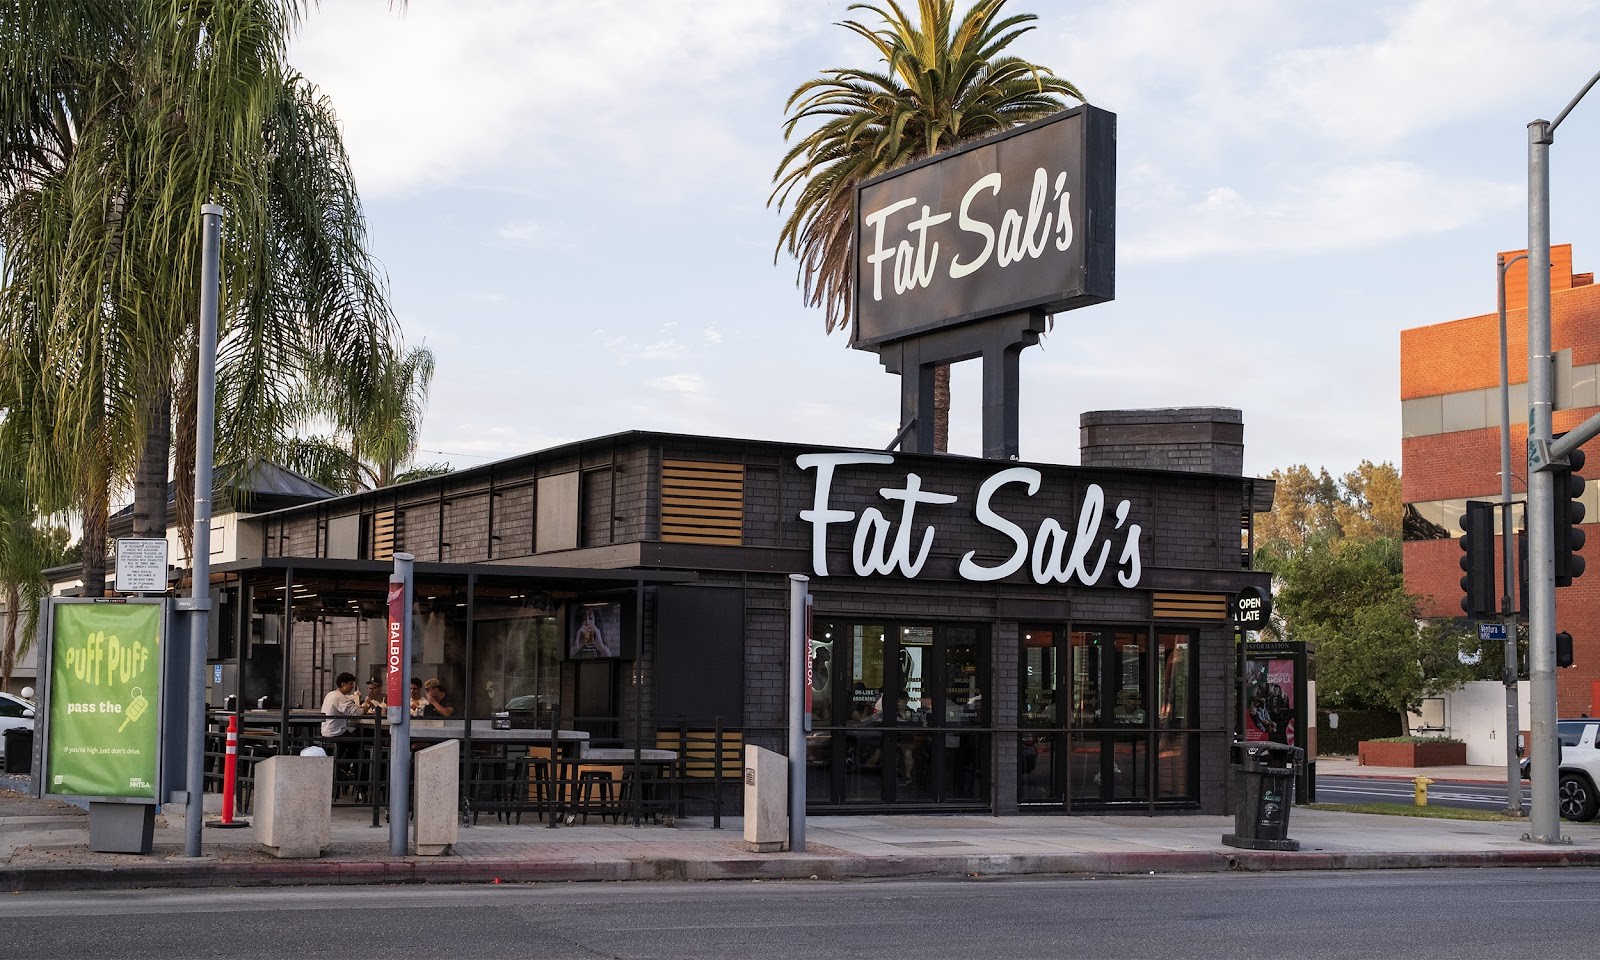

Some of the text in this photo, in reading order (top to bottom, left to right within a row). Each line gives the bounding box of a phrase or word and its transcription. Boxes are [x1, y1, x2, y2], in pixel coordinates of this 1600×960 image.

[865, 166, 1073, 302] Fat Sal's
[795, 452, 1142, 589] Fat Sal's
[1239, 597, 1261, 609] OPEN
[1240, 610, 1260, 621] LATE
[1480, 624, 1498, 634] Ventura
[389, 622, 400, 674] BALBOA
[67, 701, 122, 714] pass the
